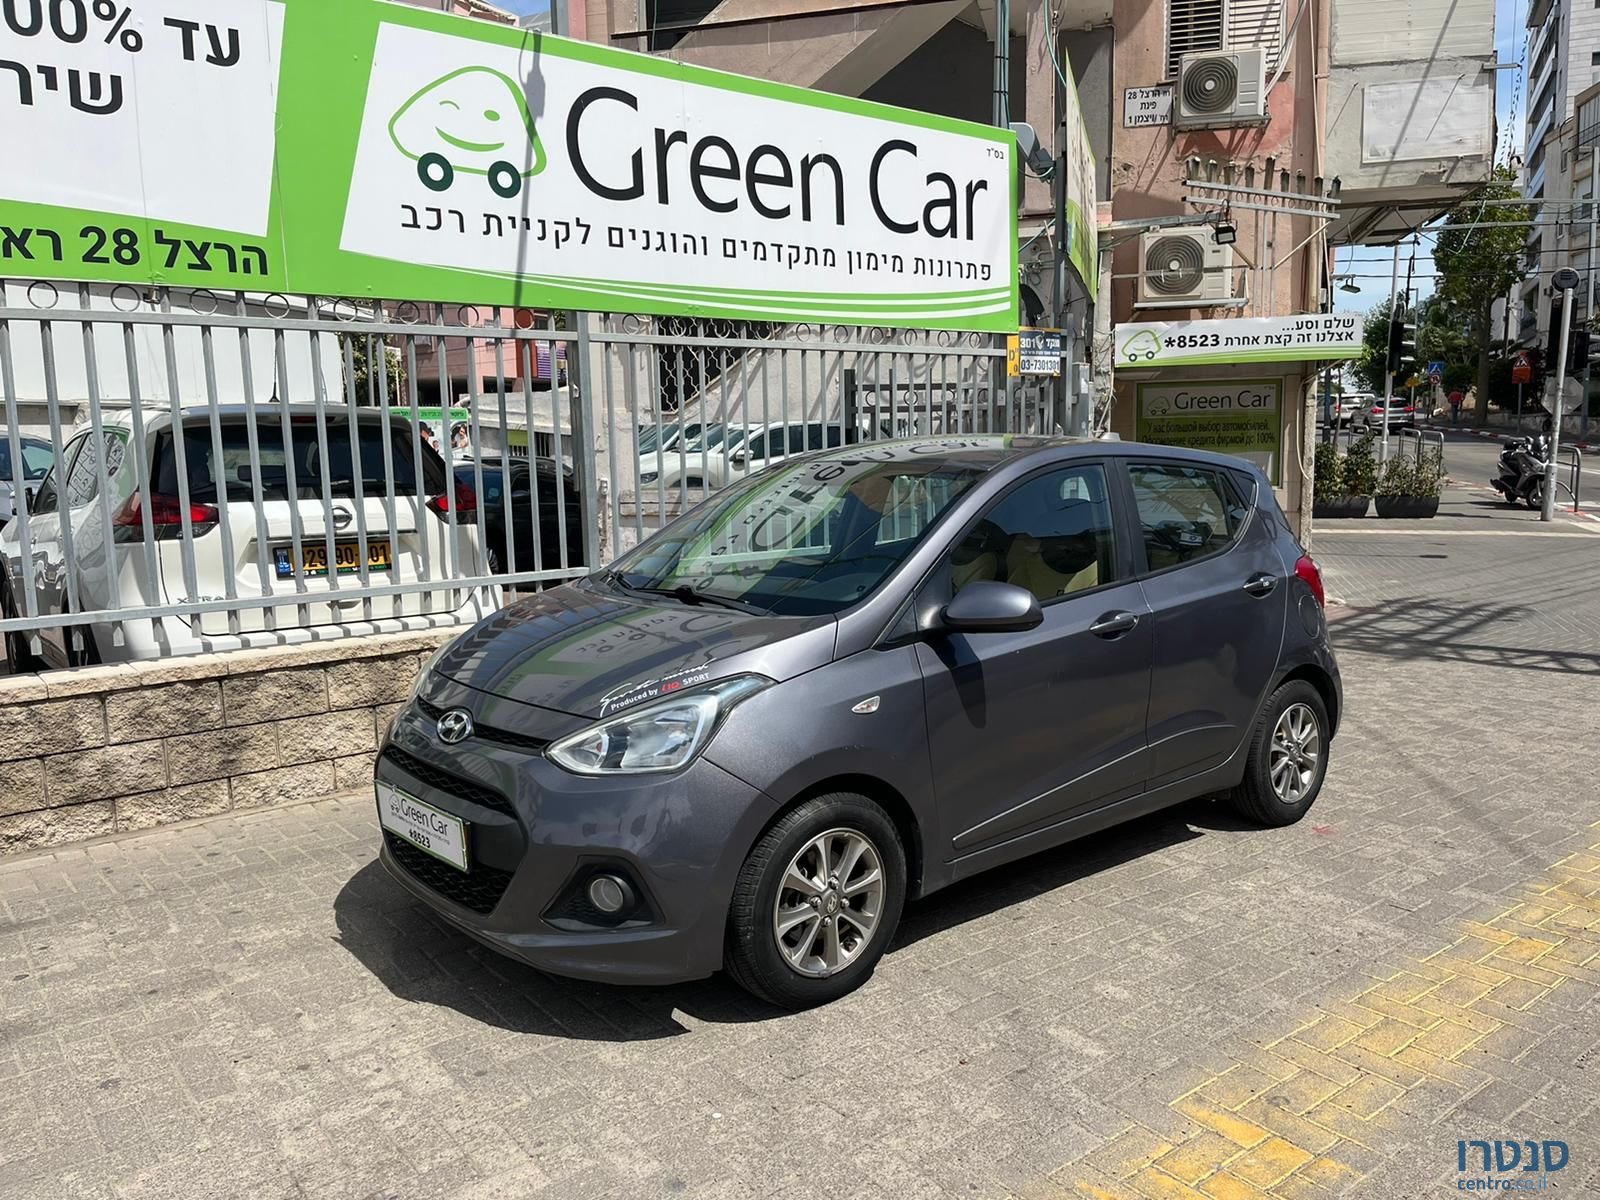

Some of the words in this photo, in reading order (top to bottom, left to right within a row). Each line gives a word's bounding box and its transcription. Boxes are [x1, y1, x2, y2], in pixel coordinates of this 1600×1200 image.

[163, 16, 241, 67] עד
[1127, 91, 1138, 100] 28
[566, 85, 845, 226] Green
[868, 139, 989, 241] Car
[986, 147, 1004, 160] בס"ד
[400, 203, 465, 233] רכב
[482, 212, 592, 249] לקניית
[79, 226, 141, 266] 28
[154, 229, 268, 276] הרצל
[607, 226, 709, 256] והוגנים
[722, 237, 837, 270] מתקדמים
[847, 249, 904, 275] מימון
[913, 256, 992, 281] פתרונות
[1316, 330, 1354, 342] אצלנו
[1324, 317, 1354, 329] שלם
[1224, 335, 1260, 347] אחרת
[1264, 334, 1292, 347] קצת
[1296, 333, 1312, 343] זה
[1174, 392, 1232, 410] Green
[1237, 390, 1271, 408] Car
[610, 690, 648, 711] Produced
[648, 687, 658, 697] by
[682, 672, 710, 686] SPORT
[401, 798, 429, 828] Green
[430, 813, 448, 836] Car
